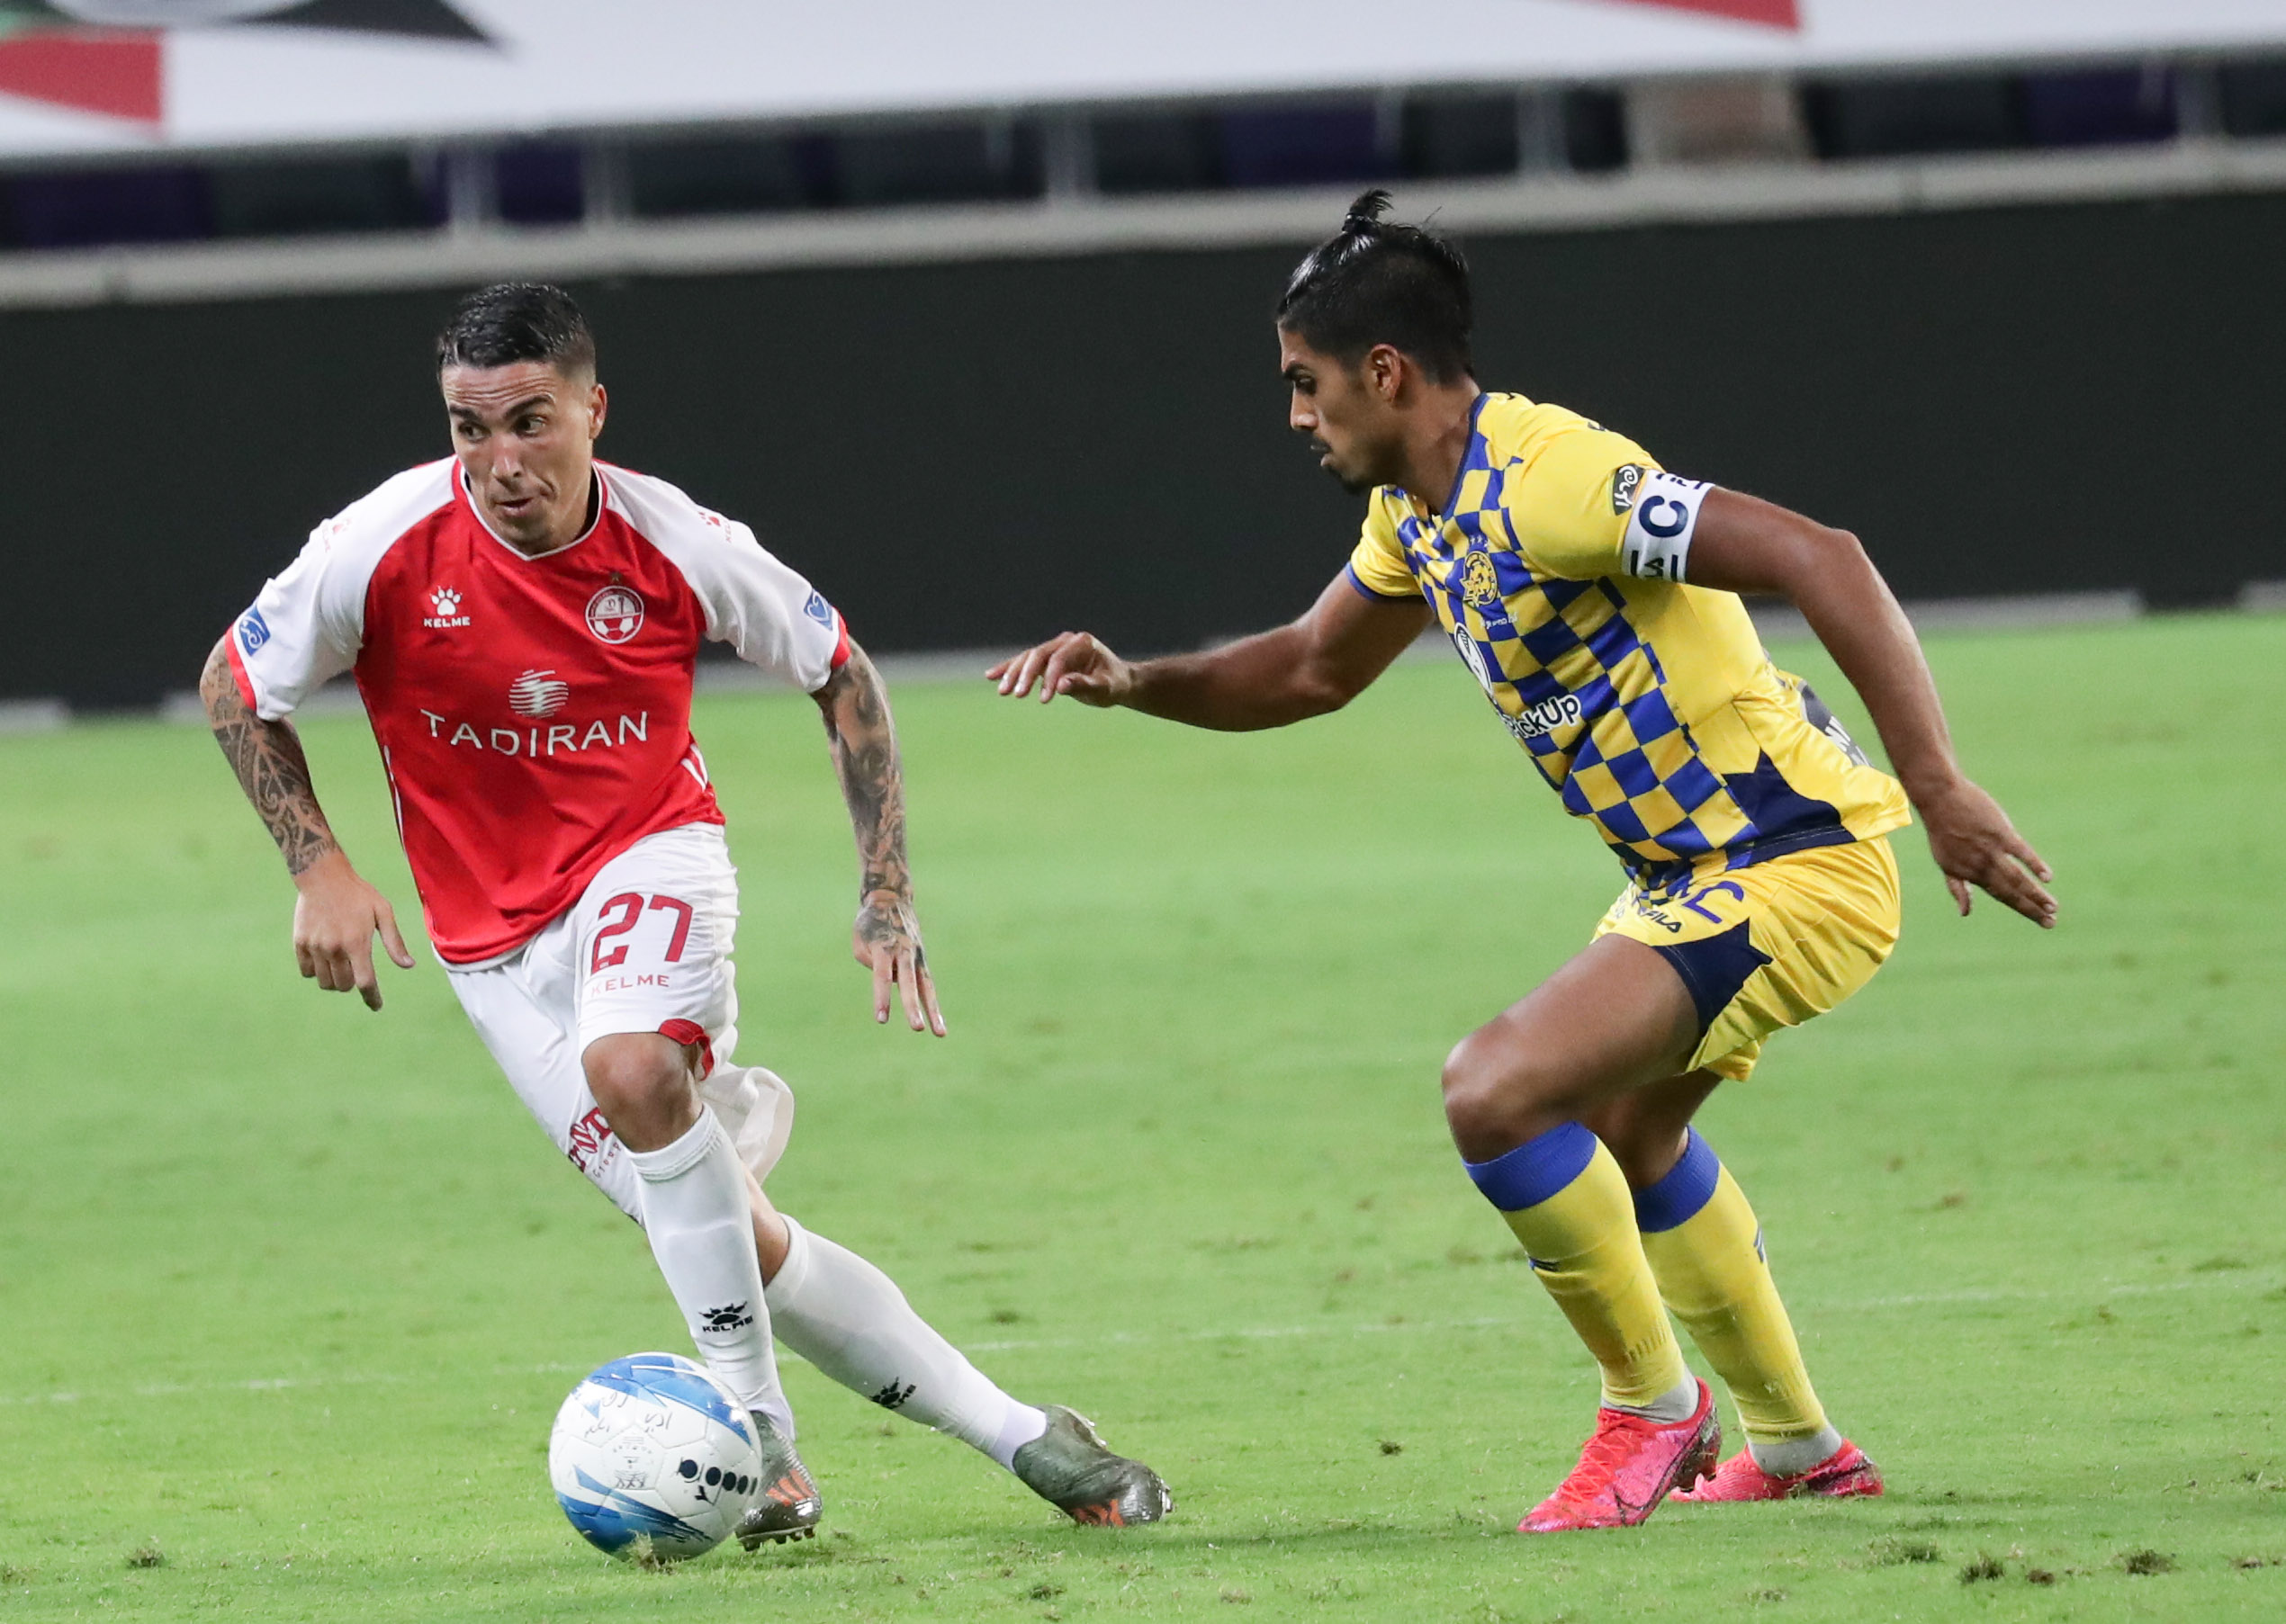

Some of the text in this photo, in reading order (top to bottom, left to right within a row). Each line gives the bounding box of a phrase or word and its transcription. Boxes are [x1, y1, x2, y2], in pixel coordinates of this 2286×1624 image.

[1639, 496, 1688, 537] C
[423, 615, 471, 628] KELME
[419, 708, 649, 758] TADIRAN
[590, 892, 693, 976] 27
[1645, 911, 1682, 933] FILA
[591, 974, 670, 998] KELME
